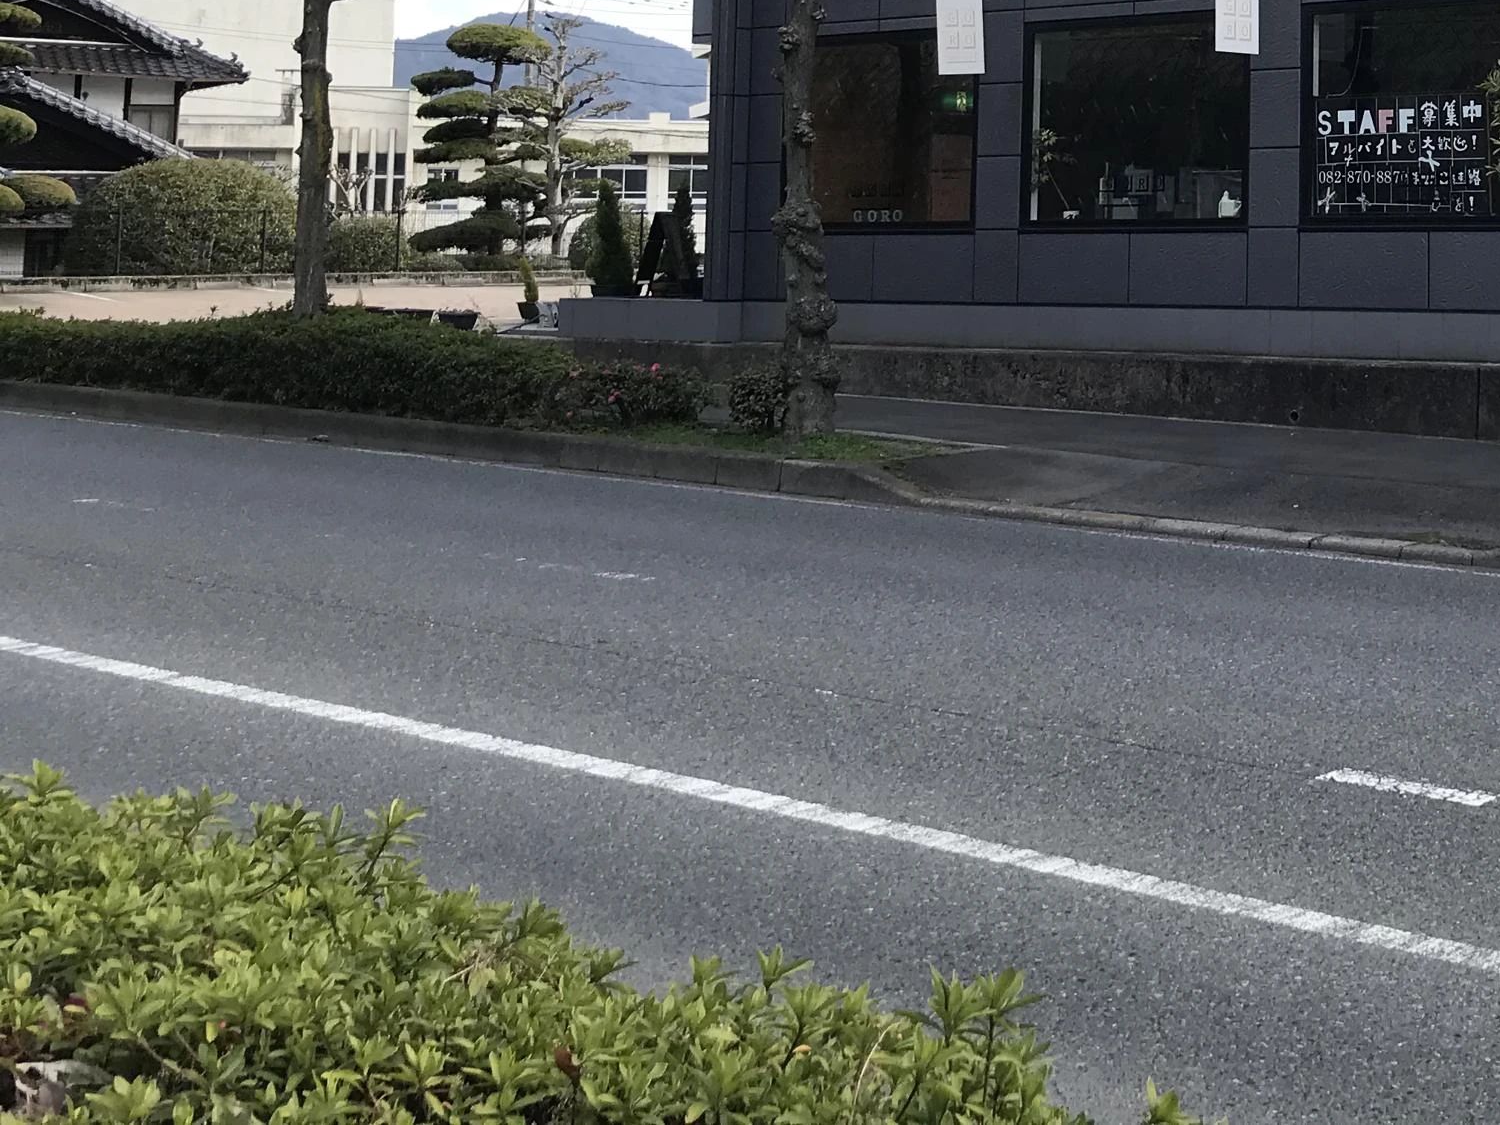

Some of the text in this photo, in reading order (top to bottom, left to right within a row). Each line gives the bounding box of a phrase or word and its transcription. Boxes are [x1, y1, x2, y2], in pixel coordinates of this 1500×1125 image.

[1317, 99, 1482, 136] STAFF 募集中
[853, 210, 903, 223] GORO
